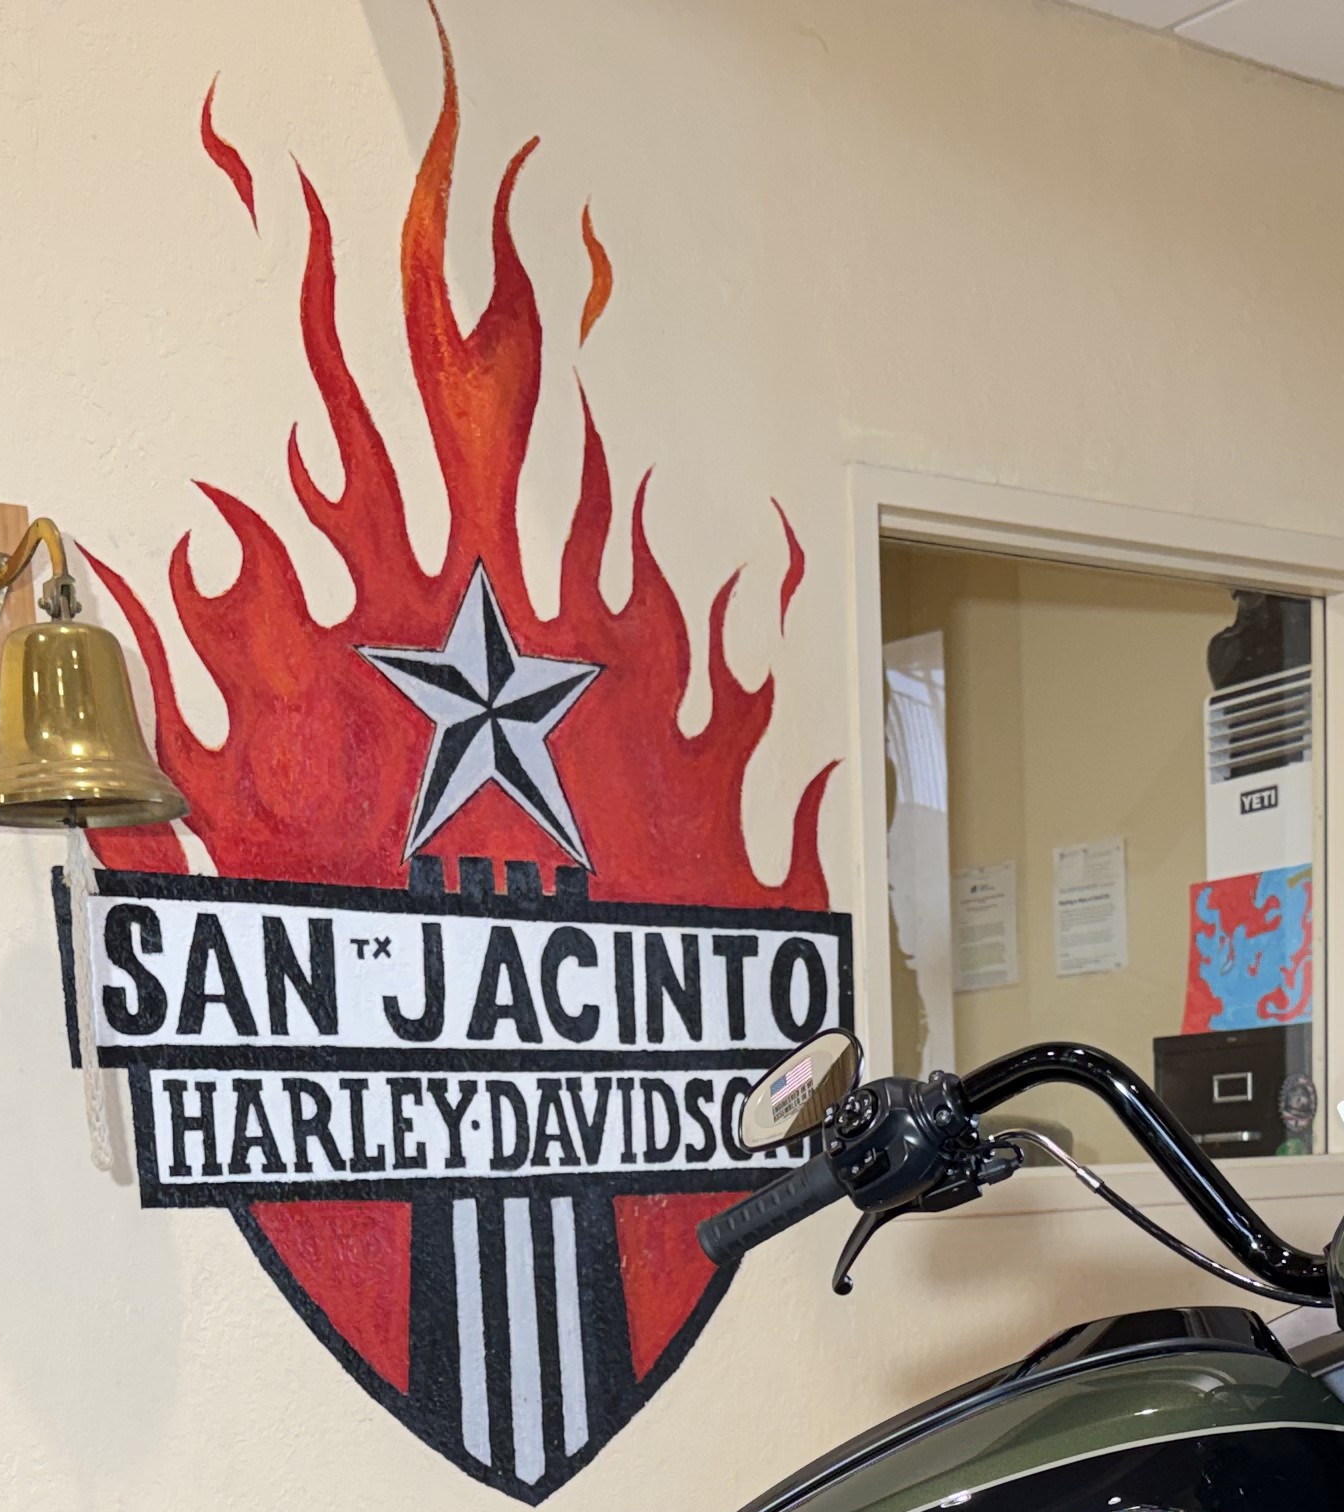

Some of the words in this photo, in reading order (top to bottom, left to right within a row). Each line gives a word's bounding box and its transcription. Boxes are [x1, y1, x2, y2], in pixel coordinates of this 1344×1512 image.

[1242, 789, 1276, 811] YETI
[102, 903, 339, 1036] SAN
[351, 936, 393, 960] TX
[383, 921, 829, 1043] JACINTO
